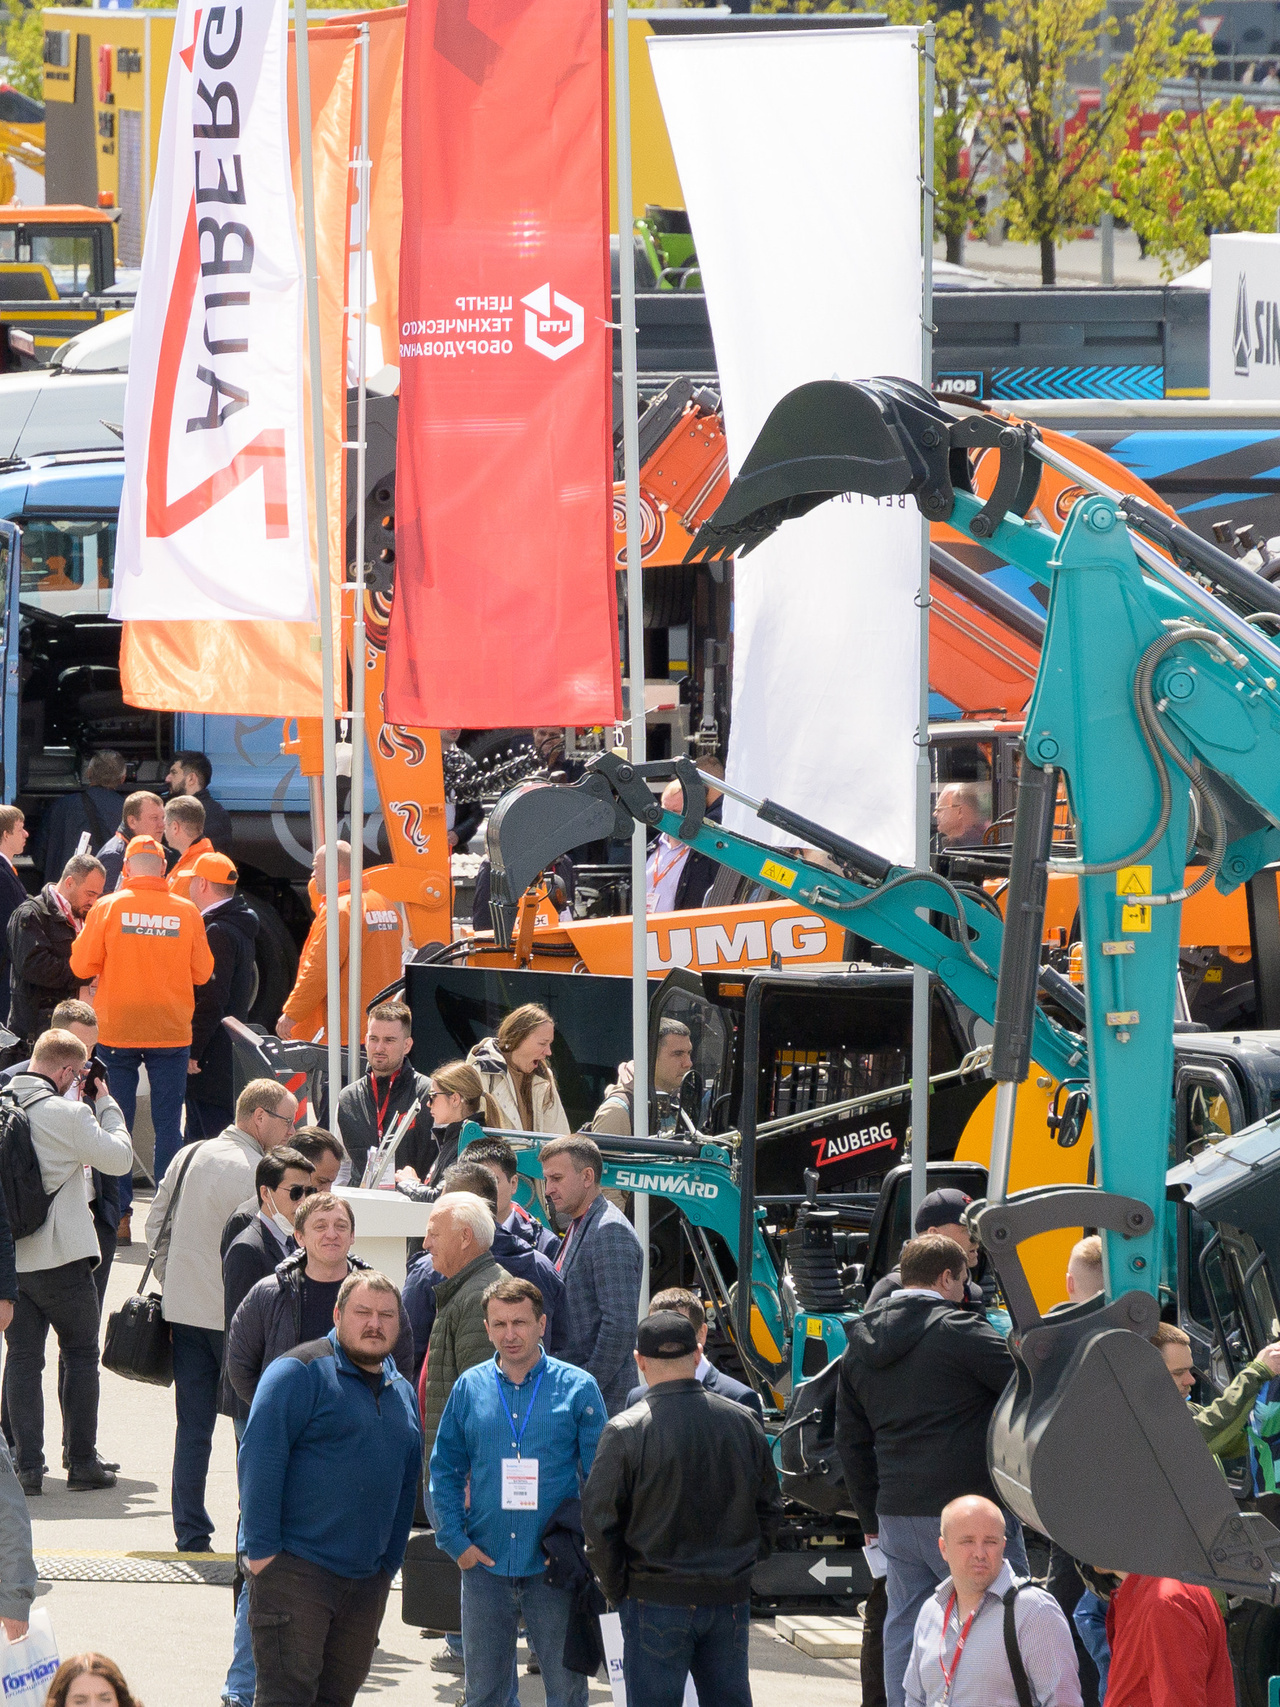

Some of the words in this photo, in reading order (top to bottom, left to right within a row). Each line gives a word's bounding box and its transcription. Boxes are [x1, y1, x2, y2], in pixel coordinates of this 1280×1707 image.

[121, 912, 181, 929] UMG
[365, 910, 398, 924] UMG
[135, 927, 167, 936] СДМ
[646, 915, 827, 972] UMG
[811, 1122, 898, 1168] ZAUBERG
[615, 1170, 719, 1199] SUNWARD
